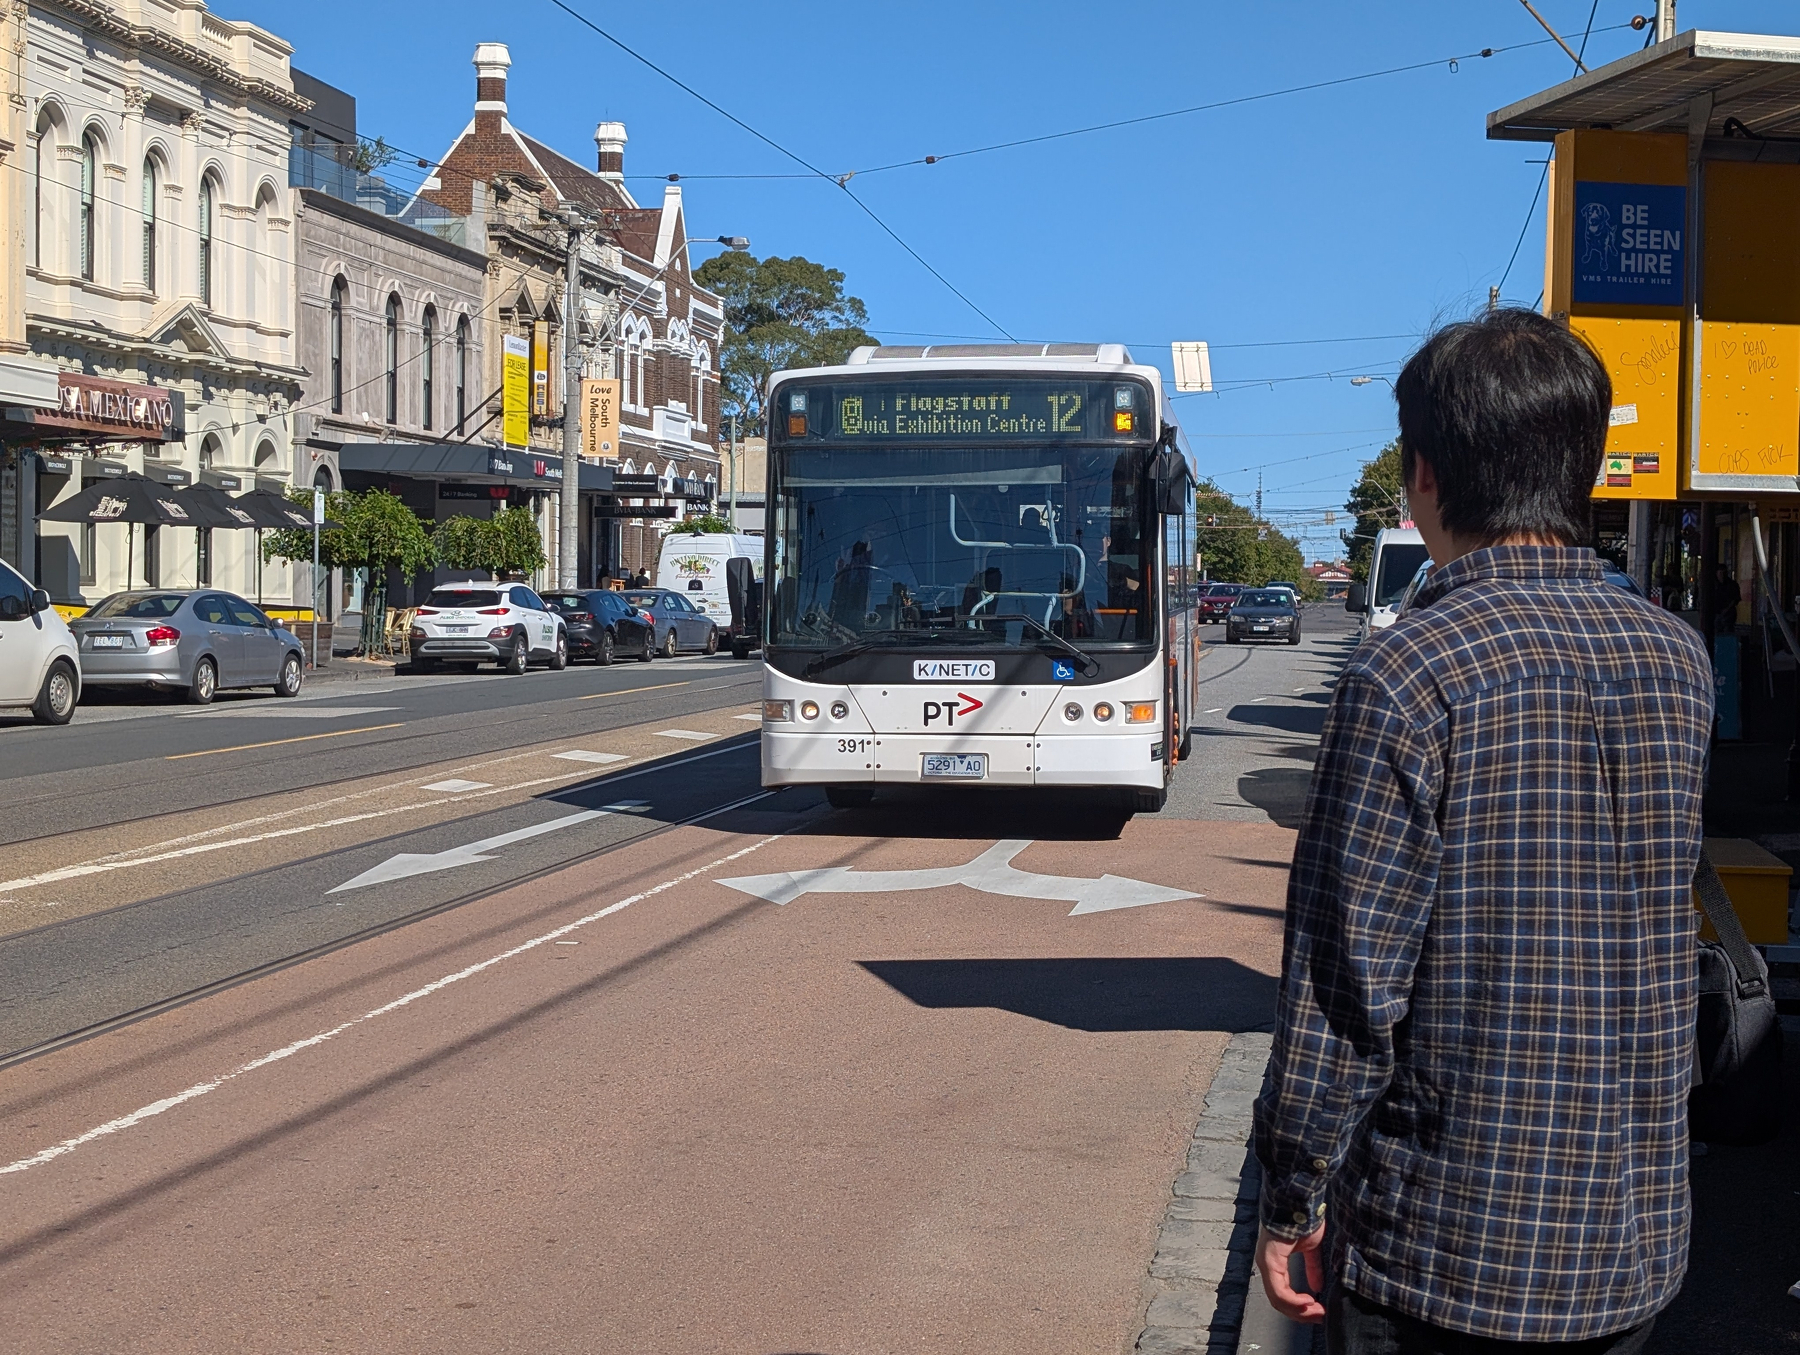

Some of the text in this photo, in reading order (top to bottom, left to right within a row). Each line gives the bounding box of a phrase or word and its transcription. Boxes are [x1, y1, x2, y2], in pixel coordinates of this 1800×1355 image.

[1621, 204, 1649, 225] BE
[1620, 228, 1681, 251] SEEN
[1620, 252, 1672, 274] HIRE
[1606, 276, 1645, 284] TRAILER
[590, 384, 612, 395] Love
[601, 398, 610, 428] South
[896, 393, 1011, 413] Flagstaff
[1047, 391, 1082, 432] 12
[590, 397, 599, 452] Melbourne
[864, 414, 1046, 434] via Exhibition Centre
[687, 503, 709, 512] BANK
[837, 738, 865, 753] 391
[927, 759, 957, 771] 5291
